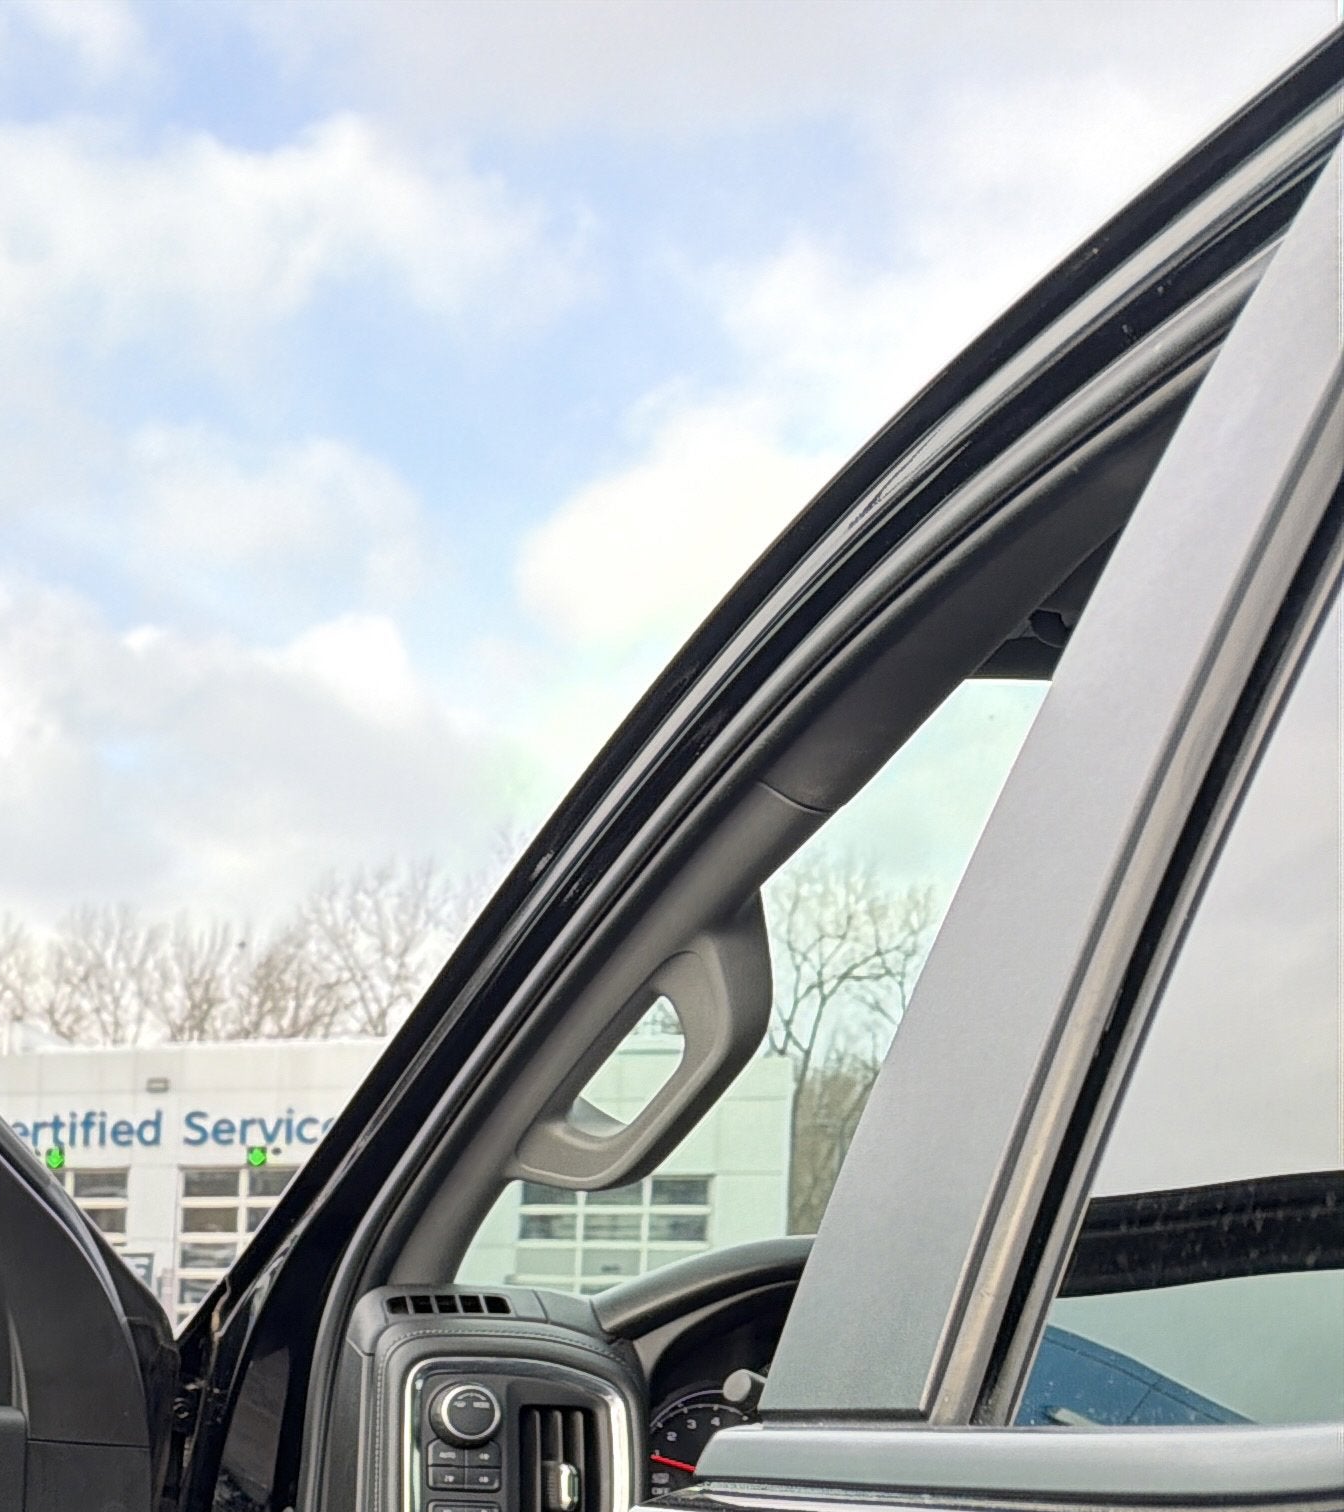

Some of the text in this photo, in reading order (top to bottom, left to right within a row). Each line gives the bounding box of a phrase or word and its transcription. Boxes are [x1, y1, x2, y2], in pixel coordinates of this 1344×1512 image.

[11, 1108, 163, 1148] ertified
[686, 1418, 697, 1430] 3
[666, 1431, 678, 1442] 2
